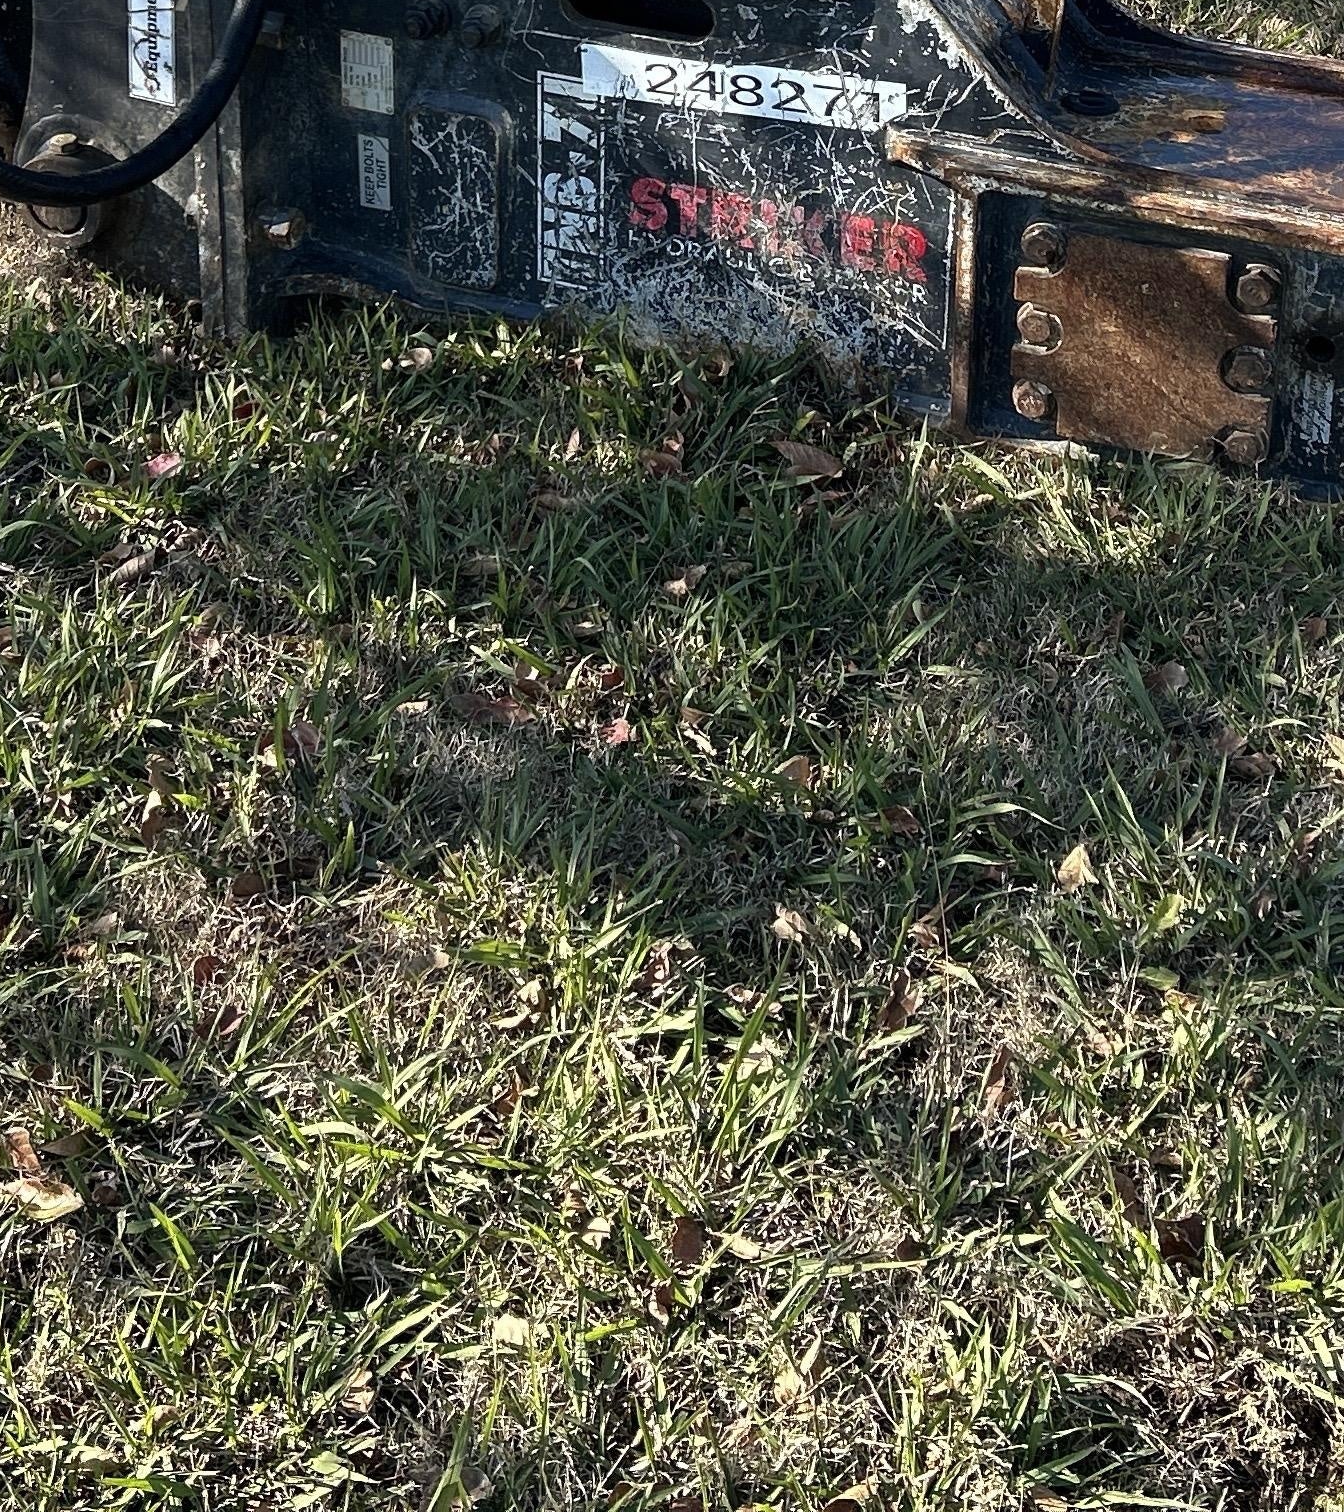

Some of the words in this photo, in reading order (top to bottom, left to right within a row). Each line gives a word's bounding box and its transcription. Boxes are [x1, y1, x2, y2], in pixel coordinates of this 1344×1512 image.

[644, 63, 881, 123] 248271
[362, 139, 374, 173] BOLTS
[363, 175, 376, 205] KEEP
[375, 159, 387, 190] TIGHT
